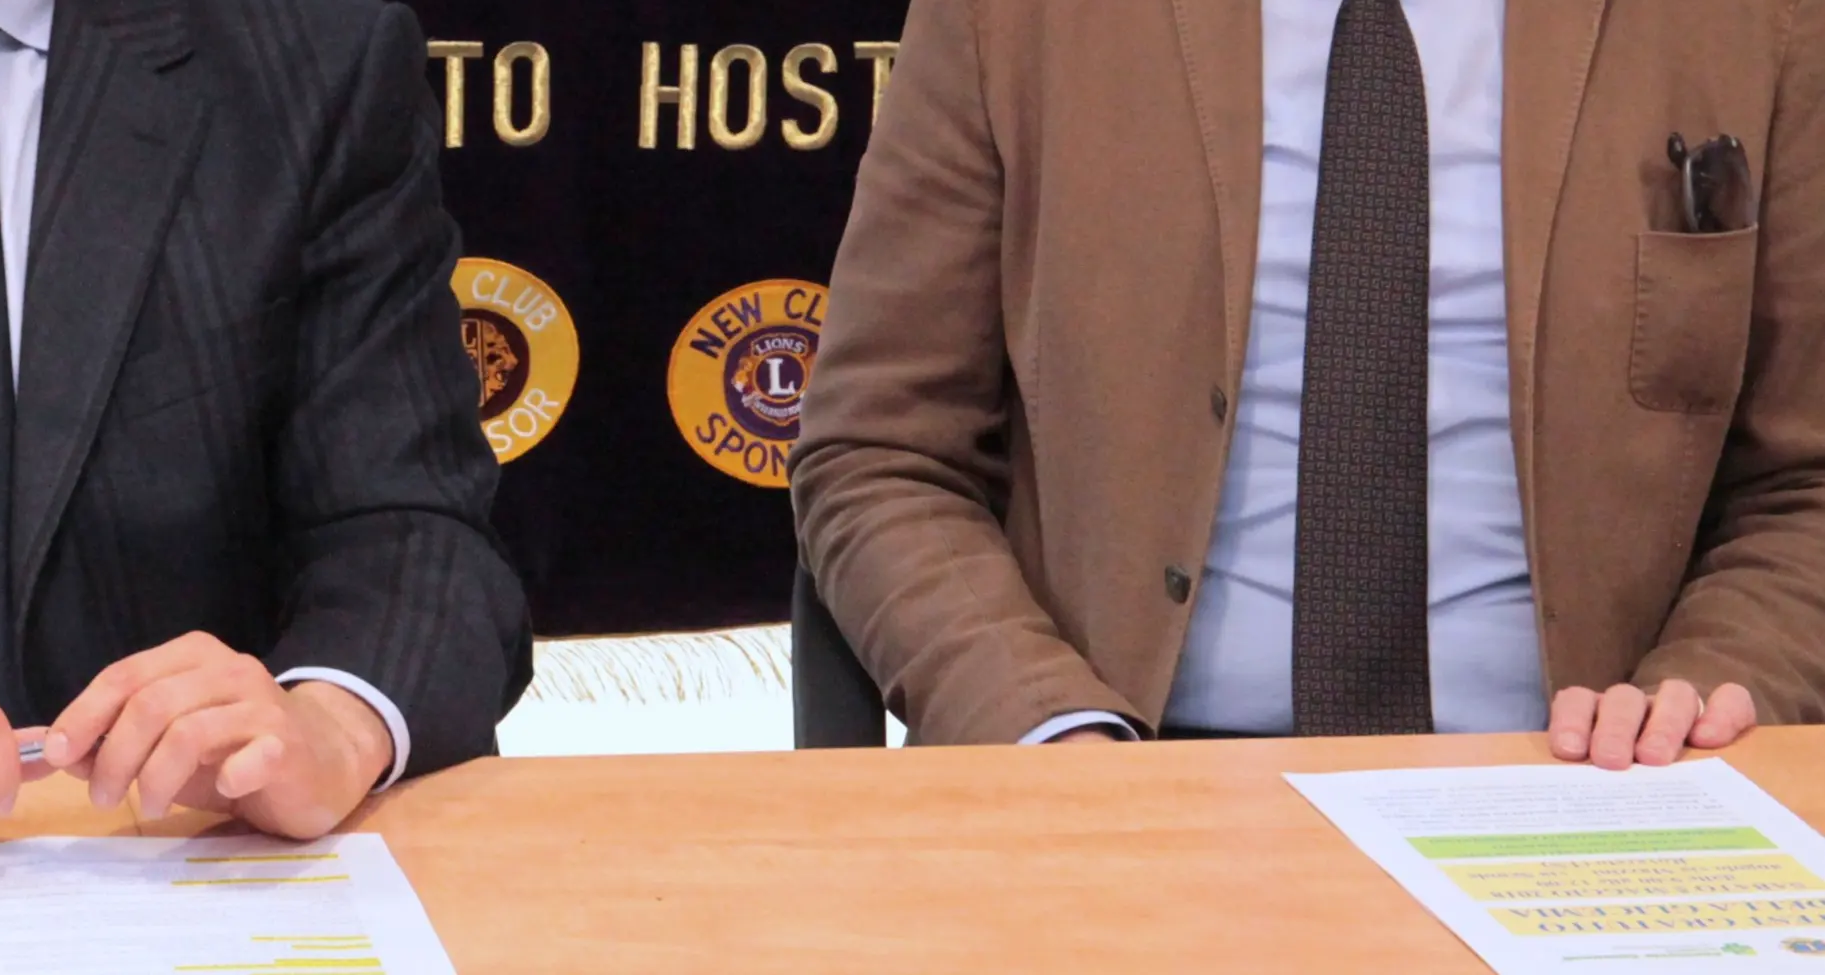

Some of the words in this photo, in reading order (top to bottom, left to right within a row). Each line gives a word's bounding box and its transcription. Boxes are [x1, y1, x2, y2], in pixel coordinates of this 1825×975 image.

[471, 270, 558, 332] CLUB
[689, 291, 764, 359] NEW
[756, 337, 805, 354] LIONS
[766, 357, 796, 396] L
